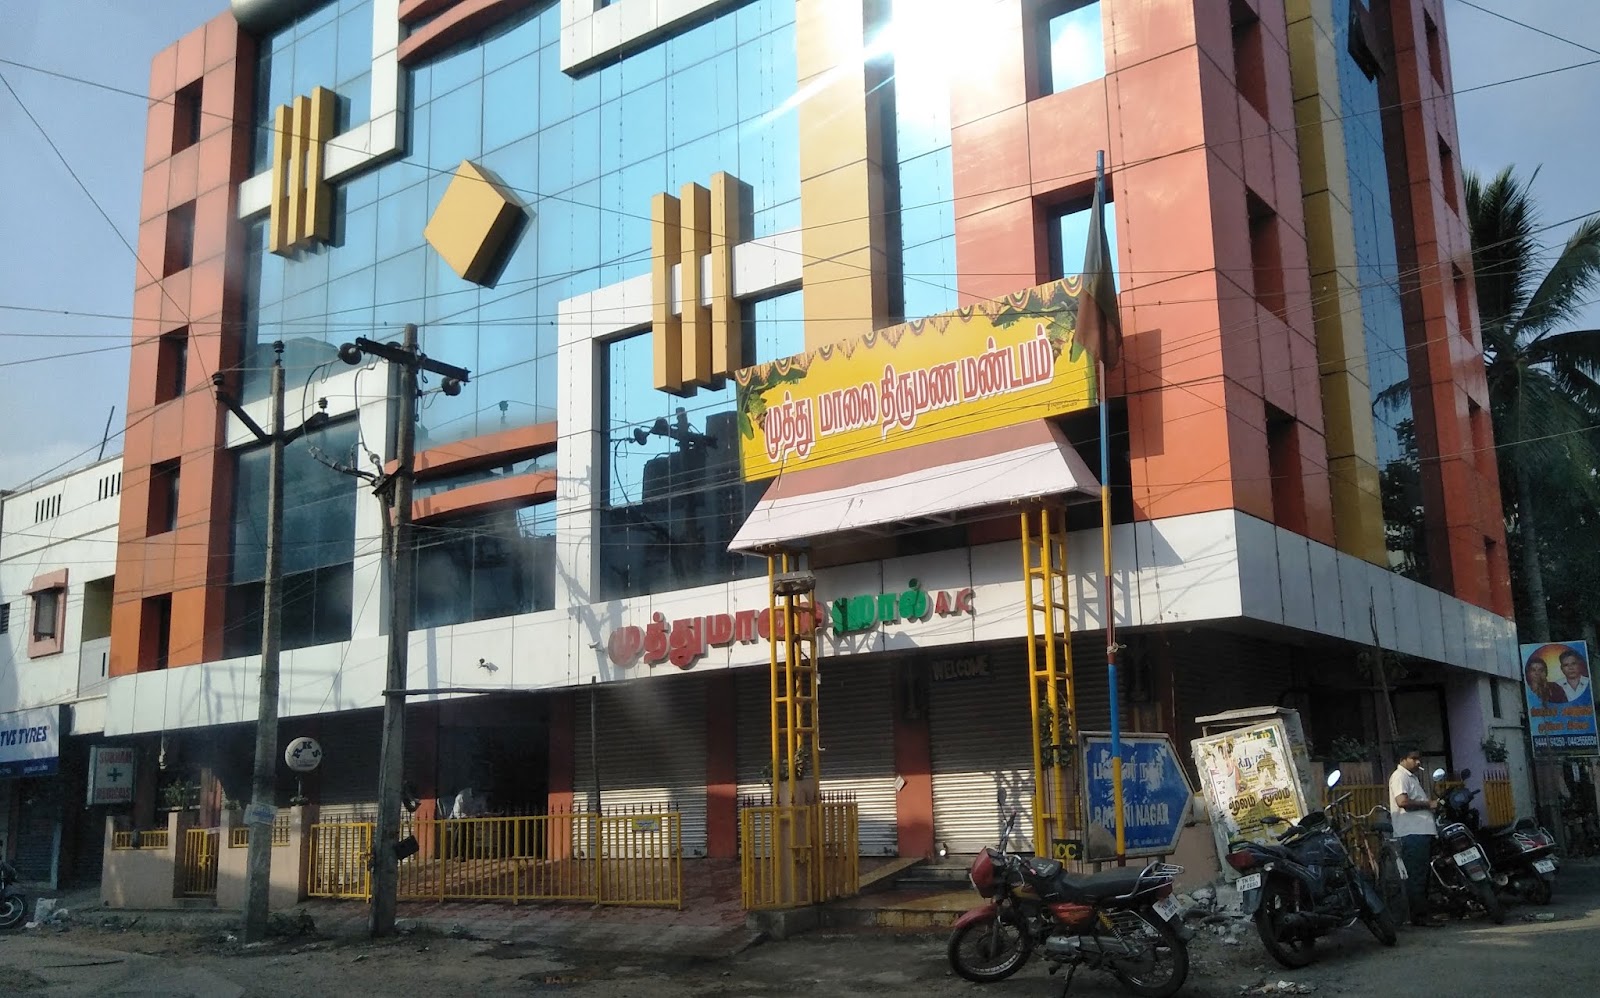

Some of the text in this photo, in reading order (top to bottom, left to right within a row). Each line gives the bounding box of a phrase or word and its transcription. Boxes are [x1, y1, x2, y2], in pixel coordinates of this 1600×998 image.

[765, 324, 1053, 462] முத்து மாலை திருமண மண்டபம்
[932, 655, 991, 681] WELCOME
[1, 726, 47, 746] TVS TYRES
[1136, 803, 1170, 826] NAGAR
